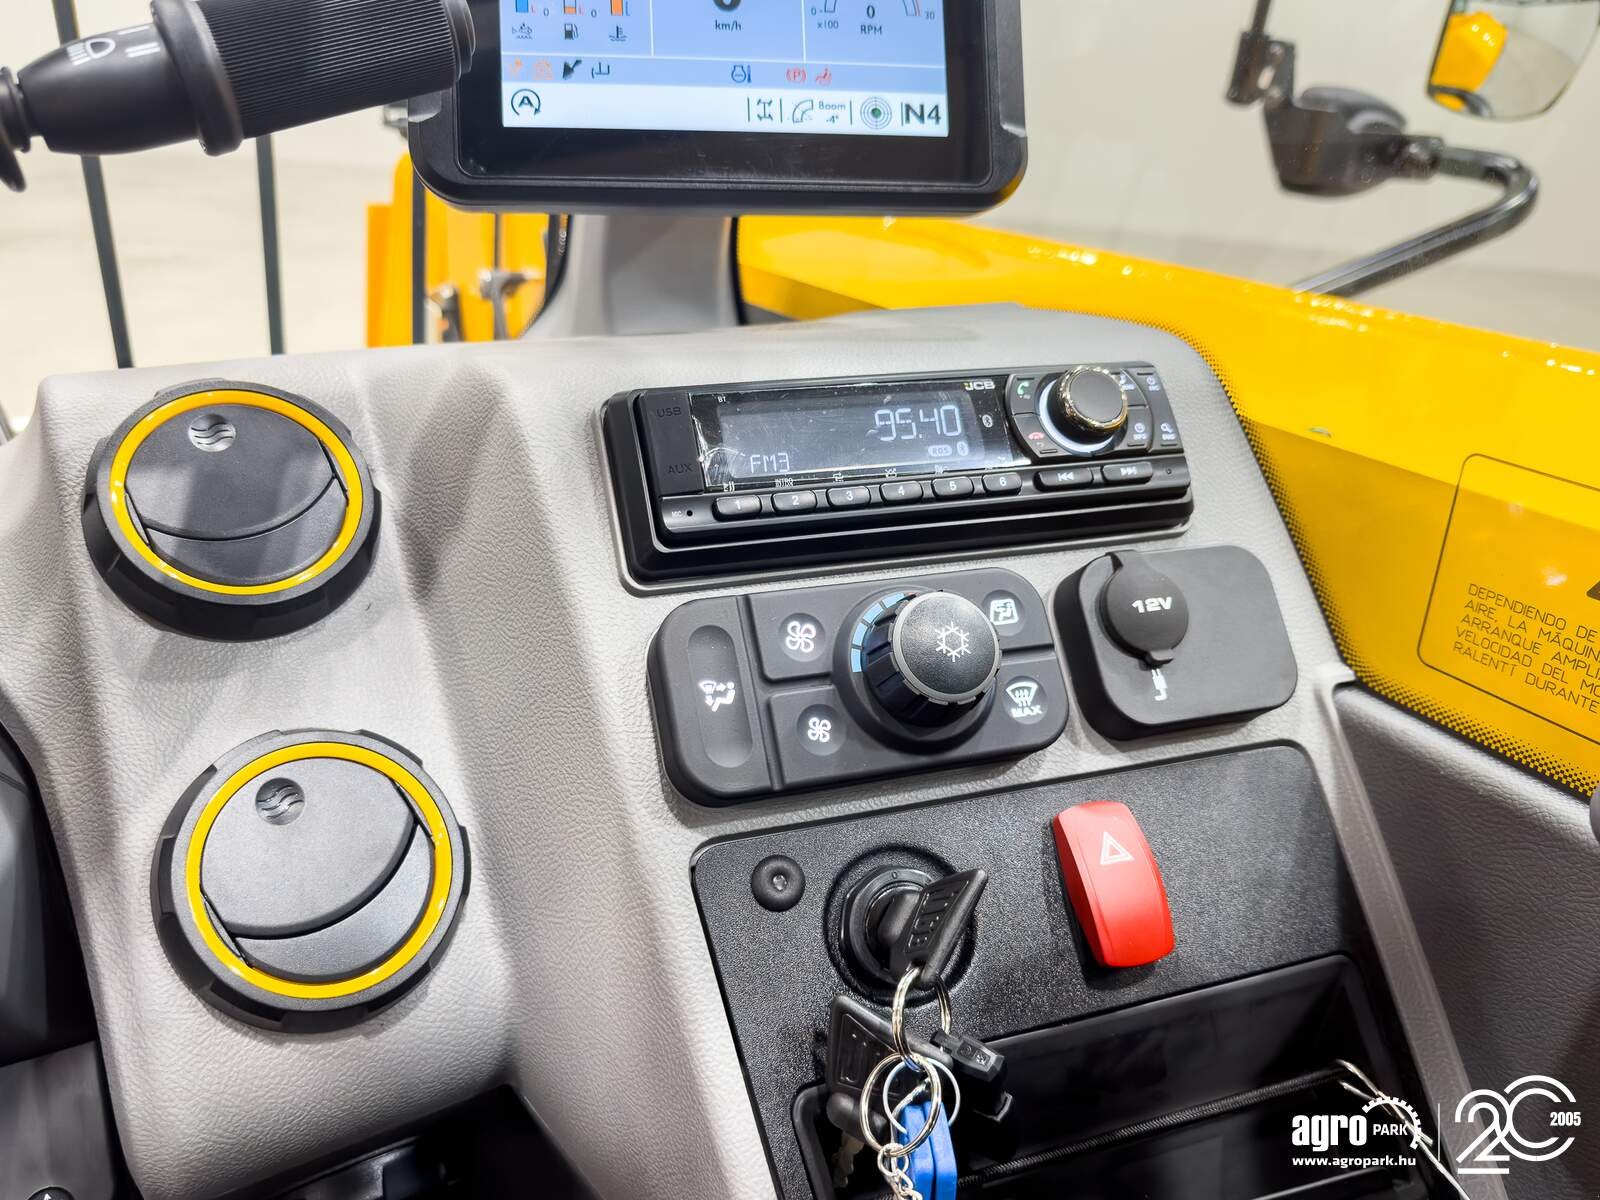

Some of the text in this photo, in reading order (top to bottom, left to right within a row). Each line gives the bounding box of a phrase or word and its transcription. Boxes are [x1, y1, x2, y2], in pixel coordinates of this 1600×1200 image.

[866, 5, 876, 19] 0
[714, 19, 742, 32] km/h
[816, 20, 839, 29] x100
[860, 25, 882, 35] RPM
[818, 101, 846, 111] Boom
[904, 103, 942, 126] N4
[963, 381, 996, 391] JCB
[656, 406, 682, 418] USB
[874, 404, 962, 442] 95.40
[667, 463, 693, 475] AUX
[750, 452, 791, 475] FM3
[791, 495, 800, 506] 2
[846, 490, 854, 501] 3
[897, 486, 905, 496] 4
[949, 481, 957, 491] 5
[999, 476, 1007, 487] 6
[1131, 596, 1172, 613] 12V
[1467, 583, 1598, 643] DEPENDIENDO DE
[1464, 599, 1600, 664] AIRE, LA MÁQUIN
[1456, 625, 1533, 668] VELOCIDAD
[1541, 662, 1569, 685] DEL
[1460, 614, 1600, 681] ARRANQUE AMPLI
[1525, 672, 1600, 714] DURANTE
[1010, 704, 1043, 718] MAX
